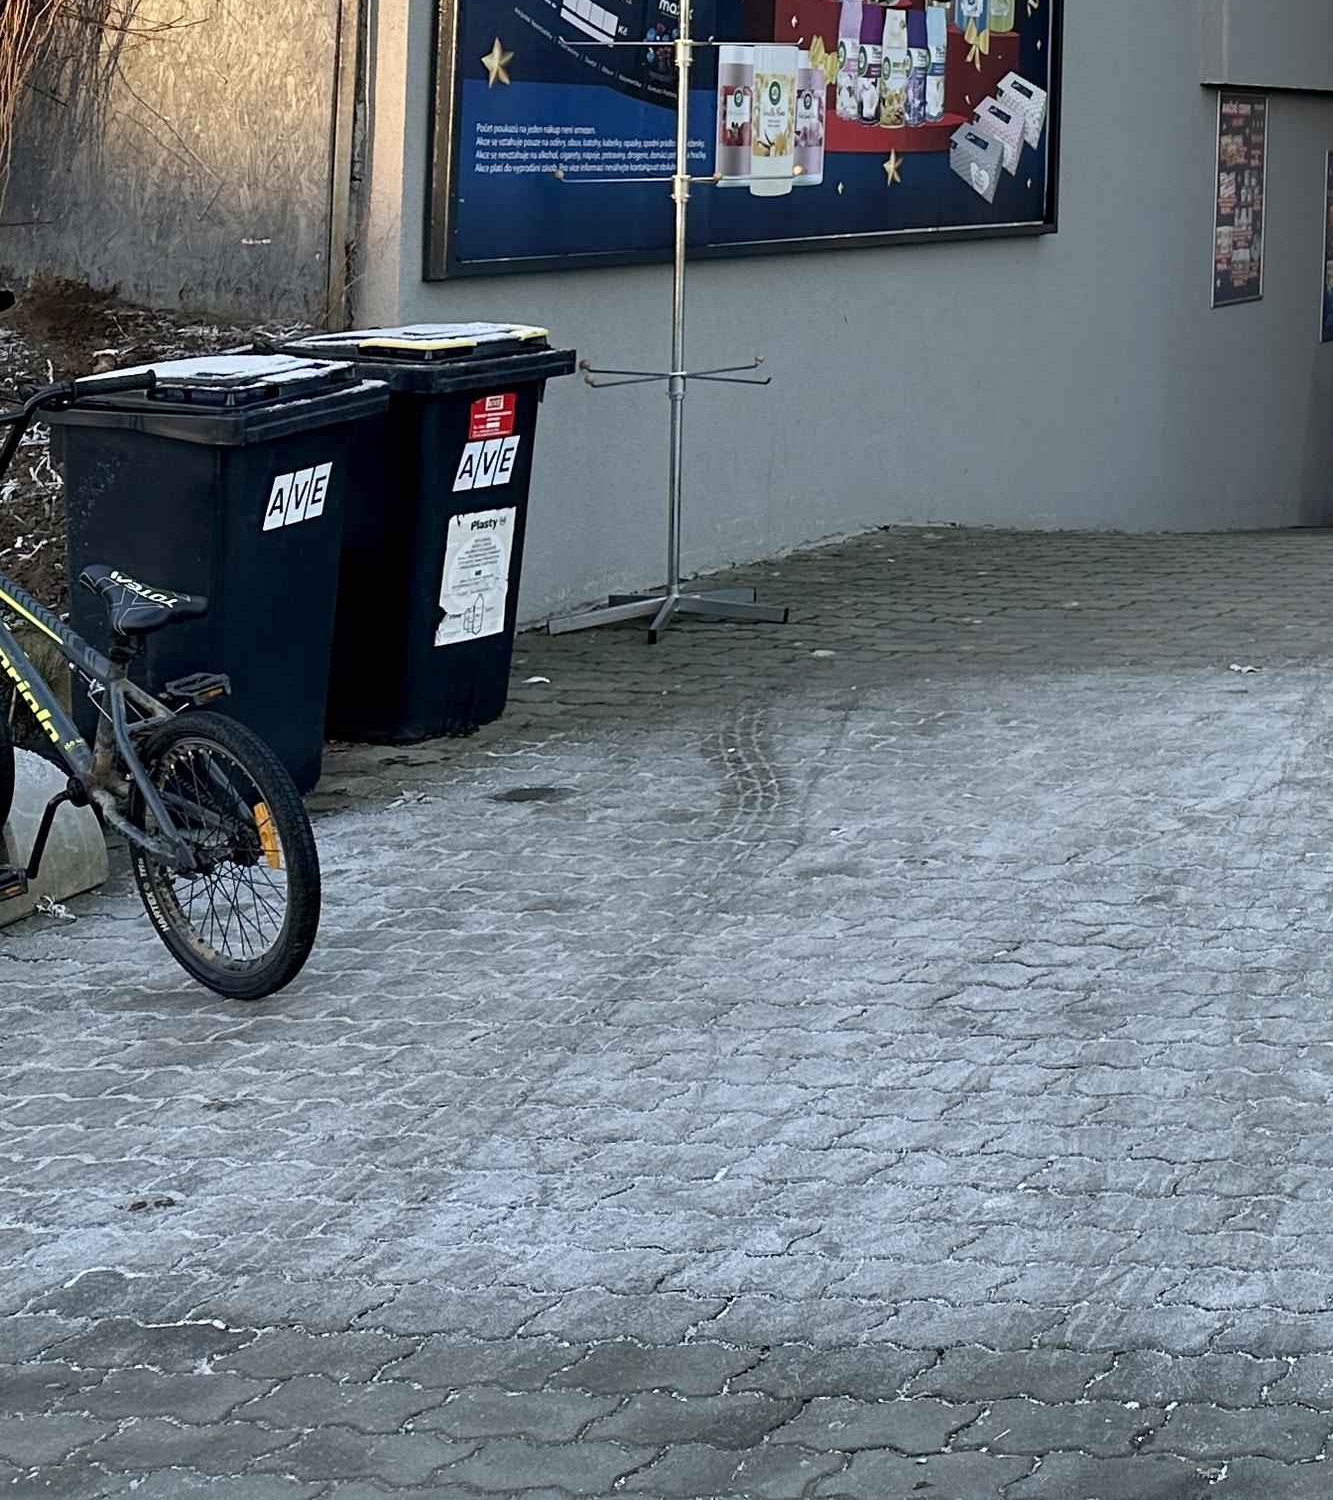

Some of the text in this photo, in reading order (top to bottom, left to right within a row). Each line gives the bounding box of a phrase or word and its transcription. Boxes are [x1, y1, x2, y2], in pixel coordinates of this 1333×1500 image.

[459, 446, 515, 479] AVE
[268, 475, 327, 516] AVE
[470, 516, 499, 531] Plasty
